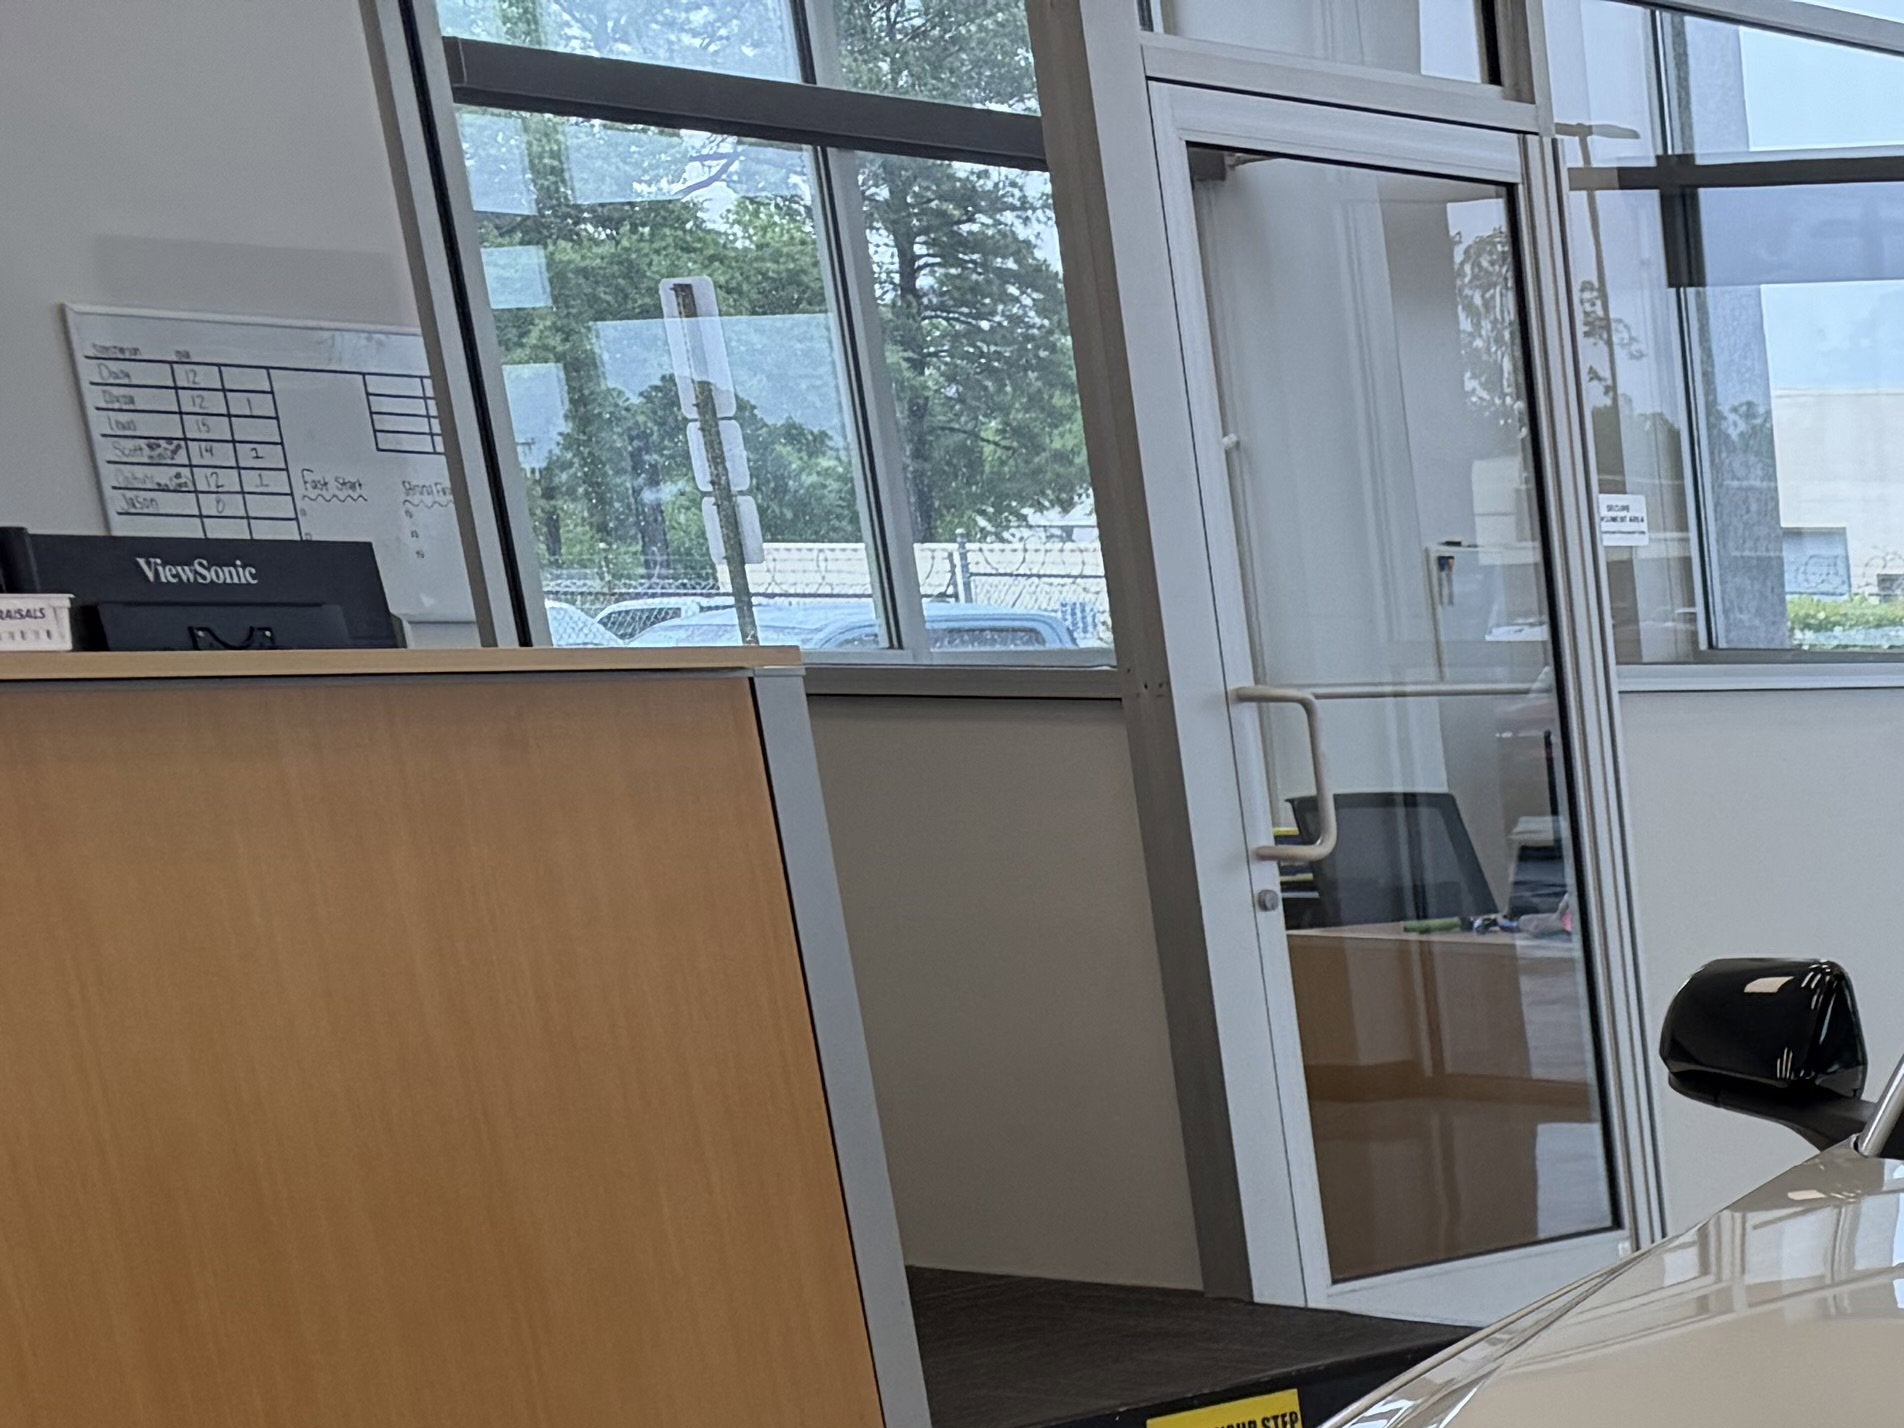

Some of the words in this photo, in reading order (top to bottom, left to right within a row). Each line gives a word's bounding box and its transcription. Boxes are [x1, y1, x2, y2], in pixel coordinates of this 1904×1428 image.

[190, 394, 208, 410] 12
[199, 443, 215, 459] 14
[204, 471, 225, 489] 12
[301, 468, 329, 491] Fast
[334, 475, 363, 492] Start
[136, 557, 259, 585] ViewSonic
